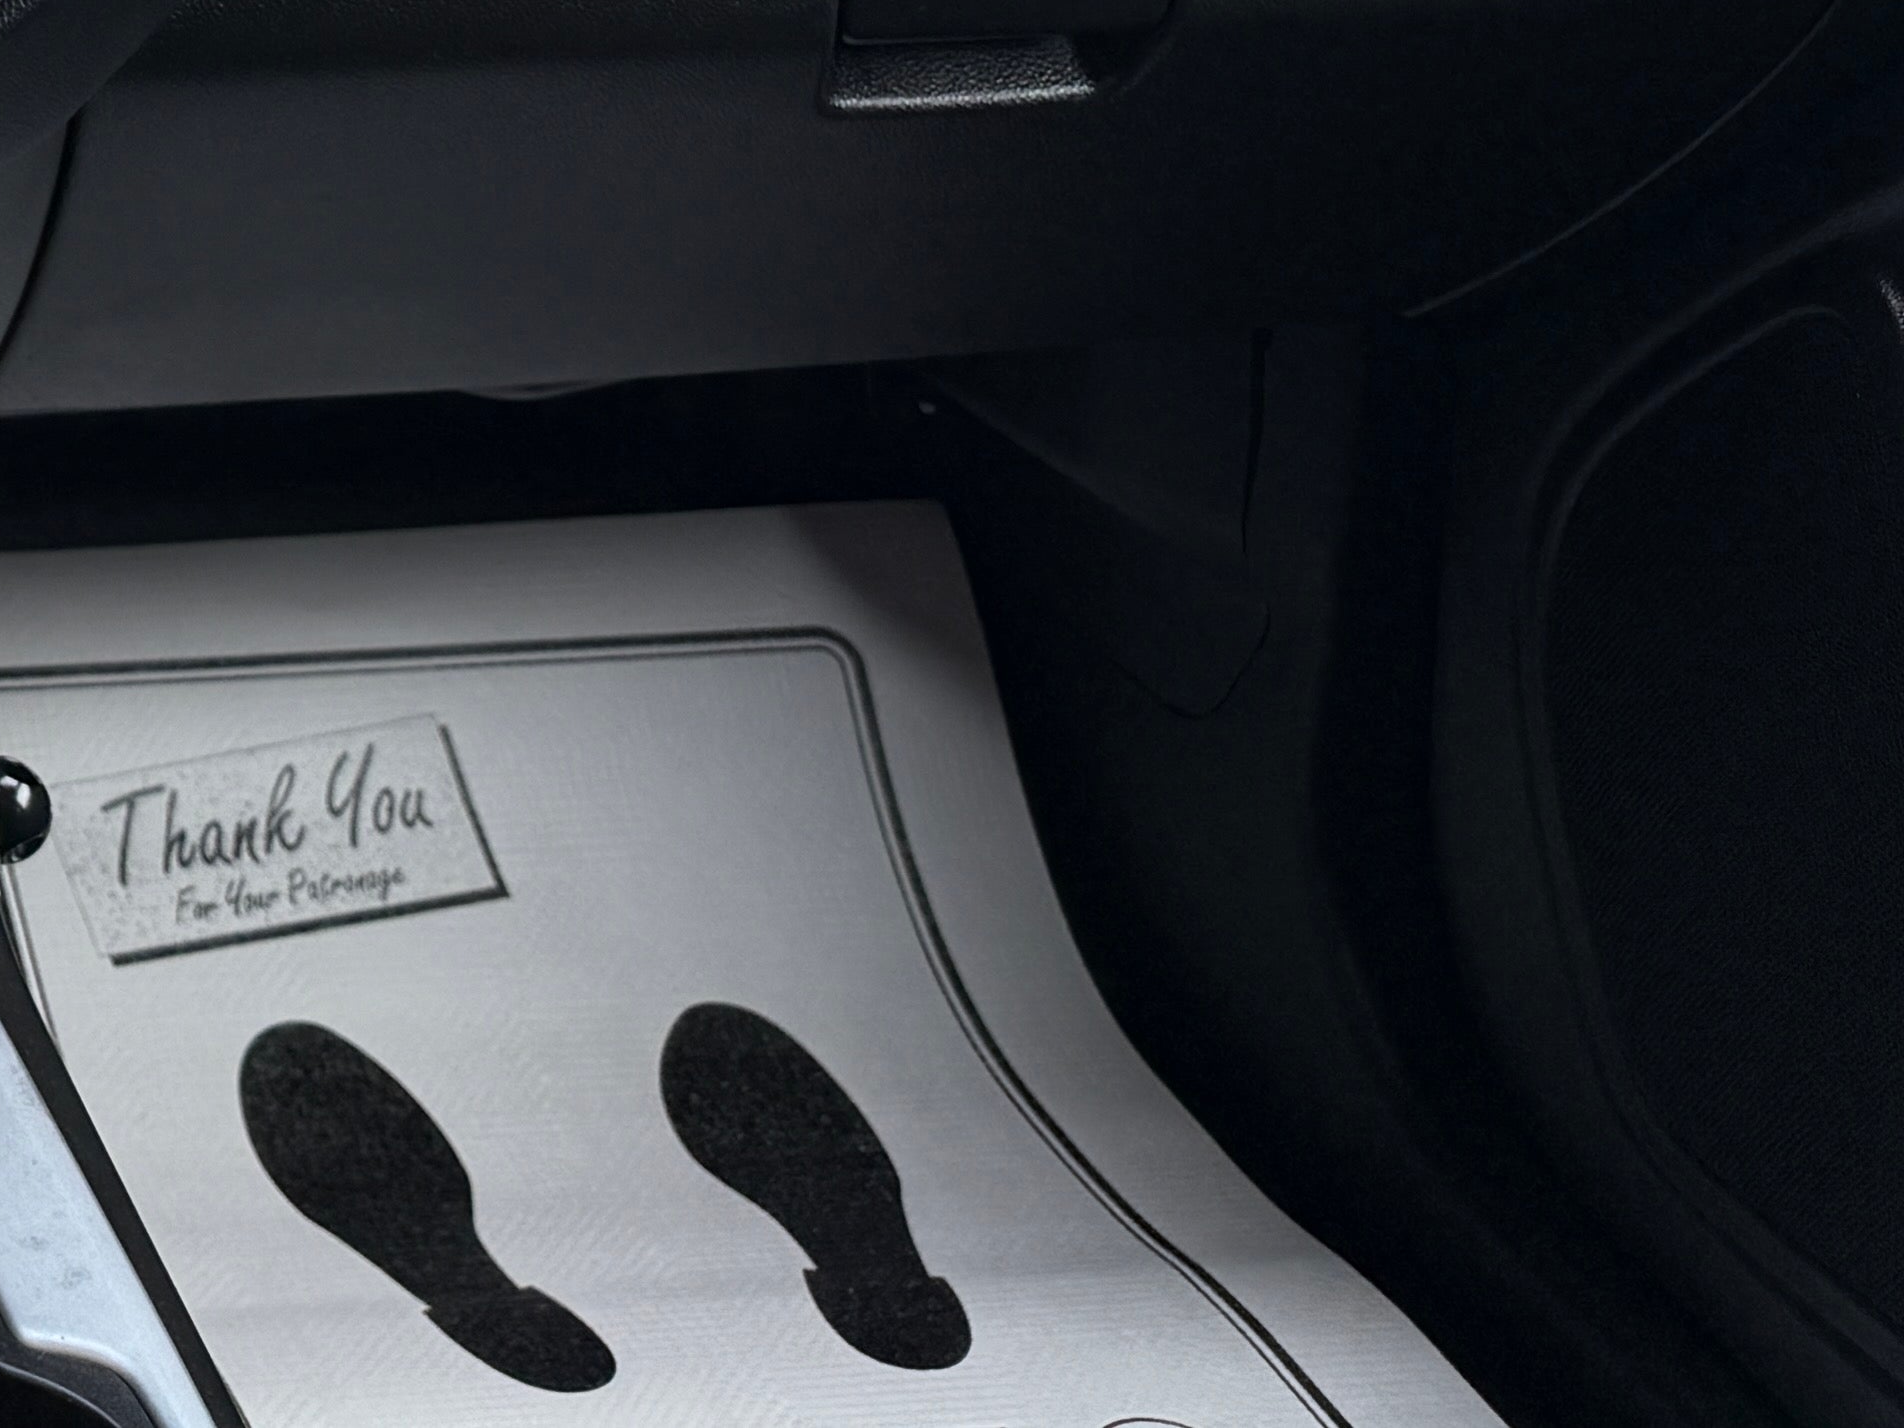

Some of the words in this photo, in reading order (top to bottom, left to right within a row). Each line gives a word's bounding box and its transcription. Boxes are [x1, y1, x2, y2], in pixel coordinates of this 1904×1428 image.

[101, 763, 306, 886] Thank
[324, 742, 434, 846] You
[175, 885, 219, 925] For
[223, 877, 280, 916] Your
[288, 864, 406, 907] Patronage
